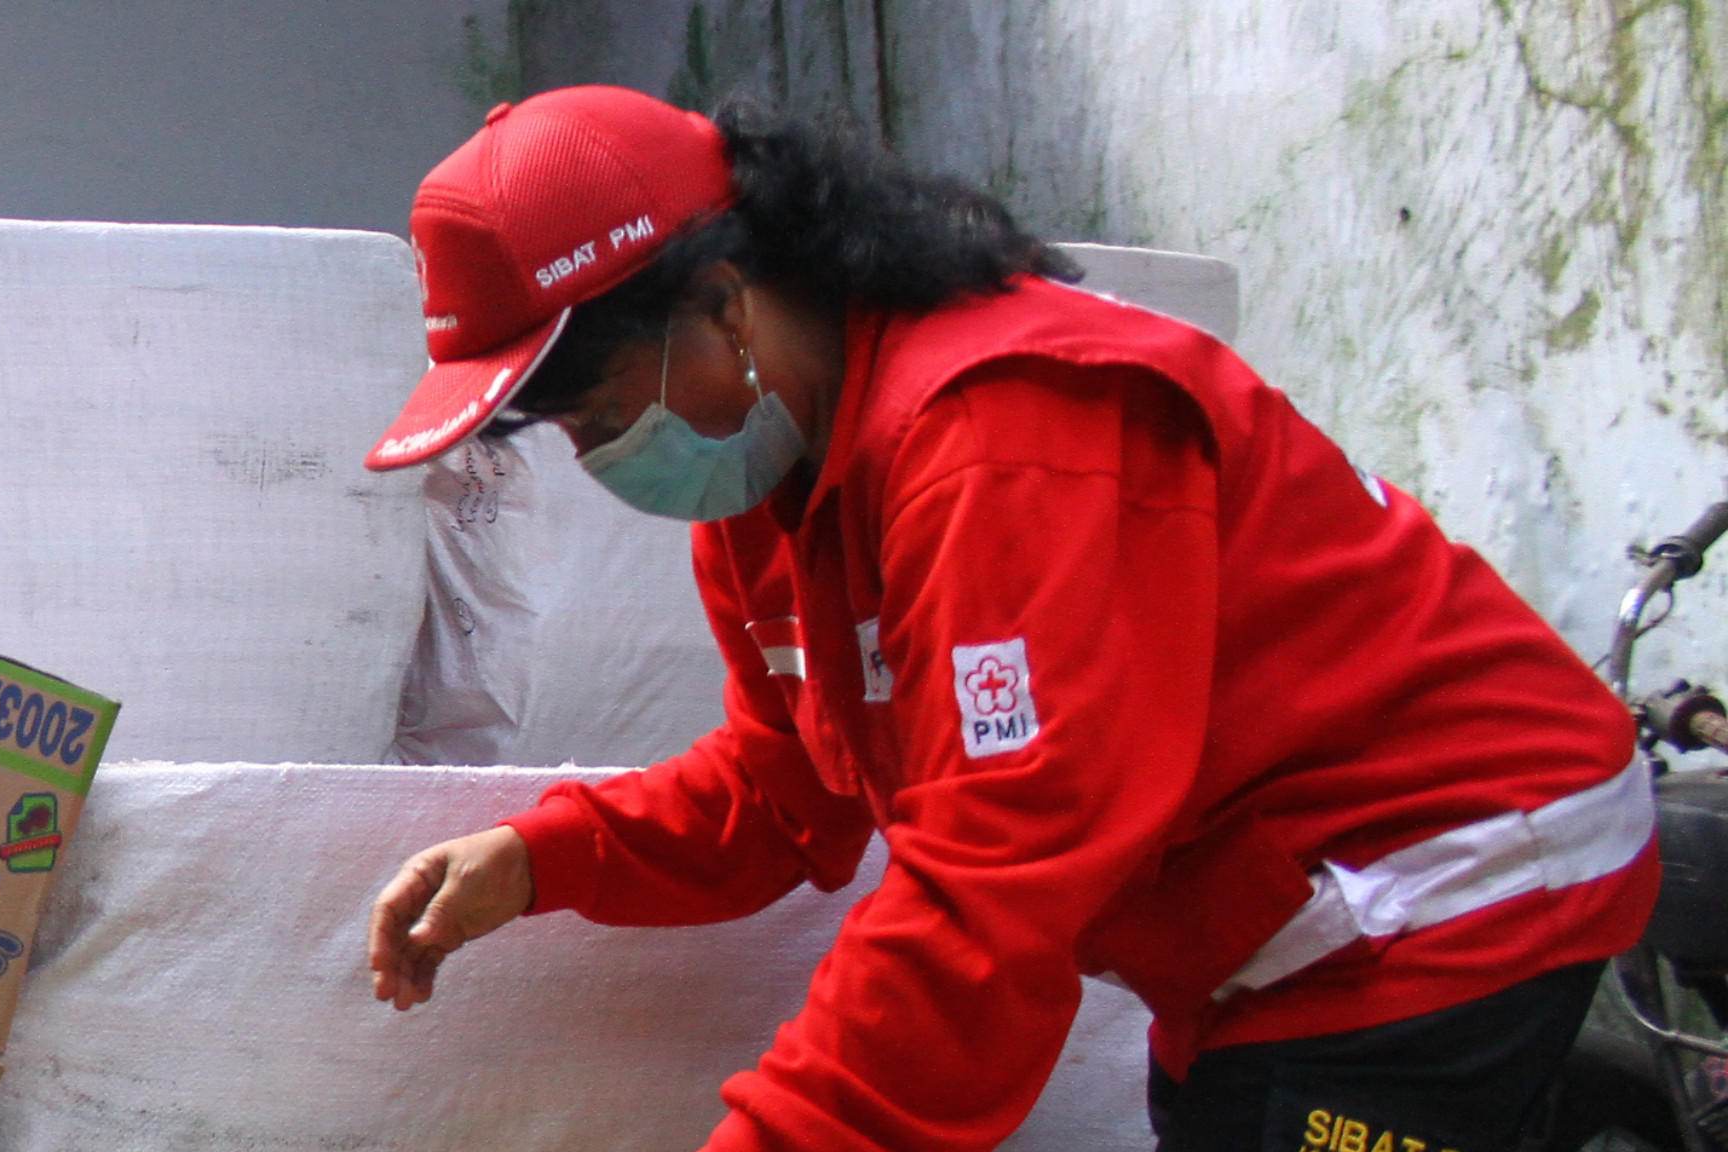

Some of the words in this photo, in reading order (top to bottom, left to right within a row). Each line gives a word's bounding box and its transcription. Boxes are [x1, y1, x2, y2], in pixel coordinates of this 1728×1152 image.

[535, 241, 597, 289] SIBAT
[609, 214, 654, 251] PMI
[974, 714, 1028, 745] PMI
